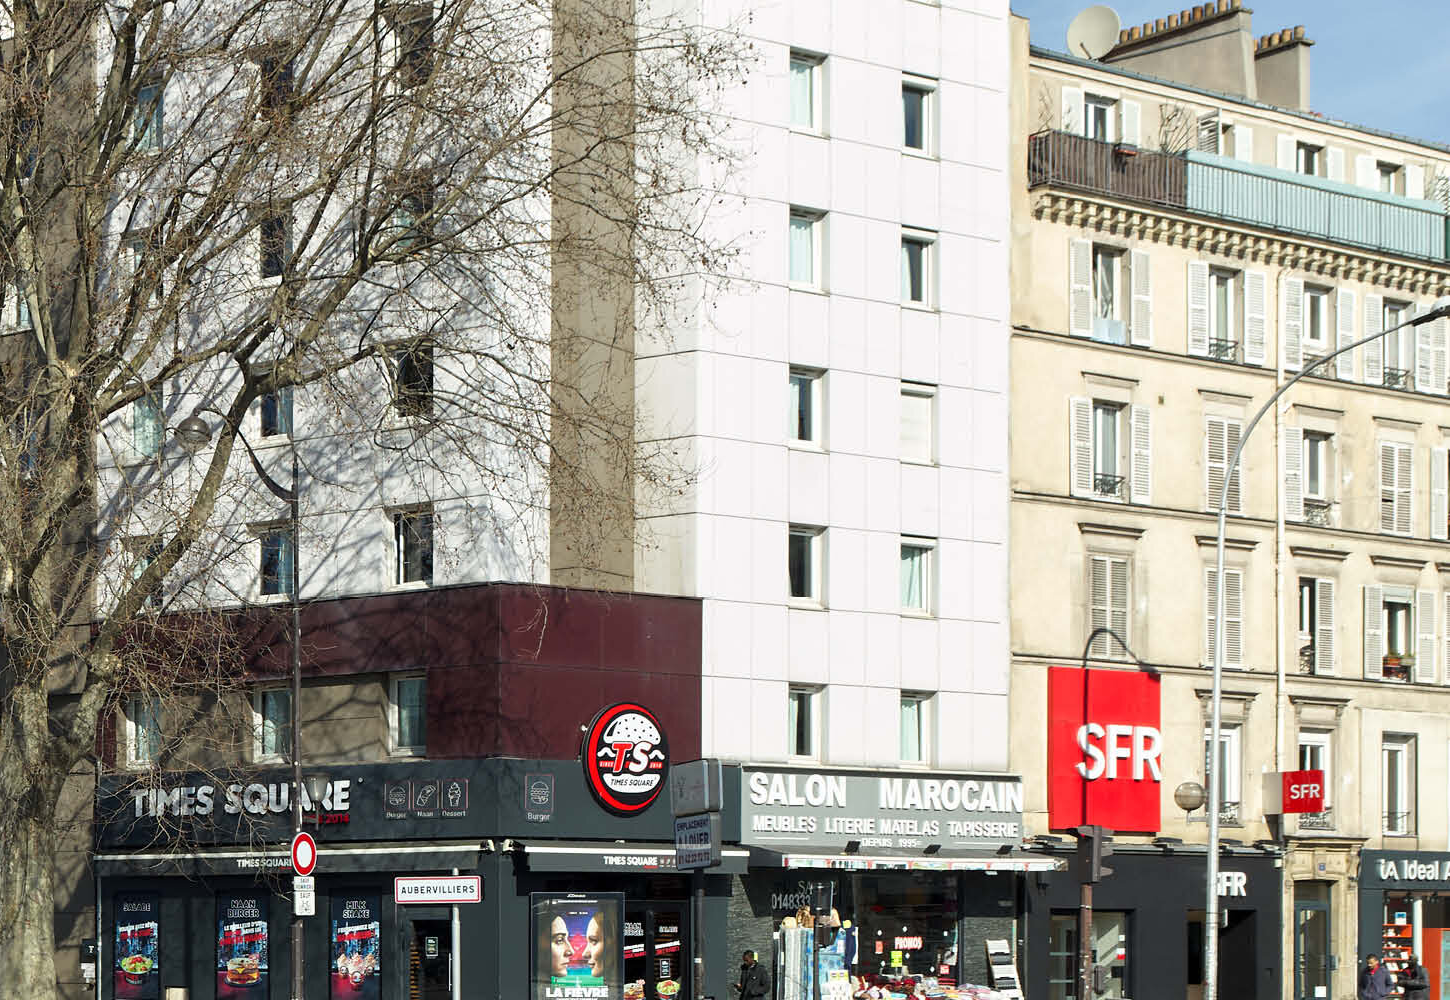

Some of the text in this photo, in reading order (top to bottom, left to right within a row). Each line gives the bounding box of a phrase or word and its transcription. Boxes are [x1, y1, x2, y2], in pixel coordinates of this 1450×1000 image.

[1075, 722, 1162, 782] SFR
[611, 778, 654, 787] TIMES SQUARE
[749, 771, 1023, 813] SALON MAROCAIN
[1290, 783, 1321, 799] SFR
[129, 785, 215, 818] TIMES
[527, 812, 551, 822] Burger
[753, 815, 1020, 838] MEUBLES LITERIE MATELAS TAPISSERIE
[861, 837, 892, 848] DEPUIS
[237, 859, 260, 868] TIMES
[603, 856, 658, 866] TIMES SQUARE
[1404, 860, 1439, 880] Ideal
[401, 885, 475, 895] AUBERVILLIERS
[123, 903, 151, 912] SALADE
[230, 900, 256, 909] NAAN
[346, 900, 367, 909] MILK
[227, 909, 260, 918] BURGER
[342, 909, 370, 919] SHAKE
[545, 987, 564, 998] LA
